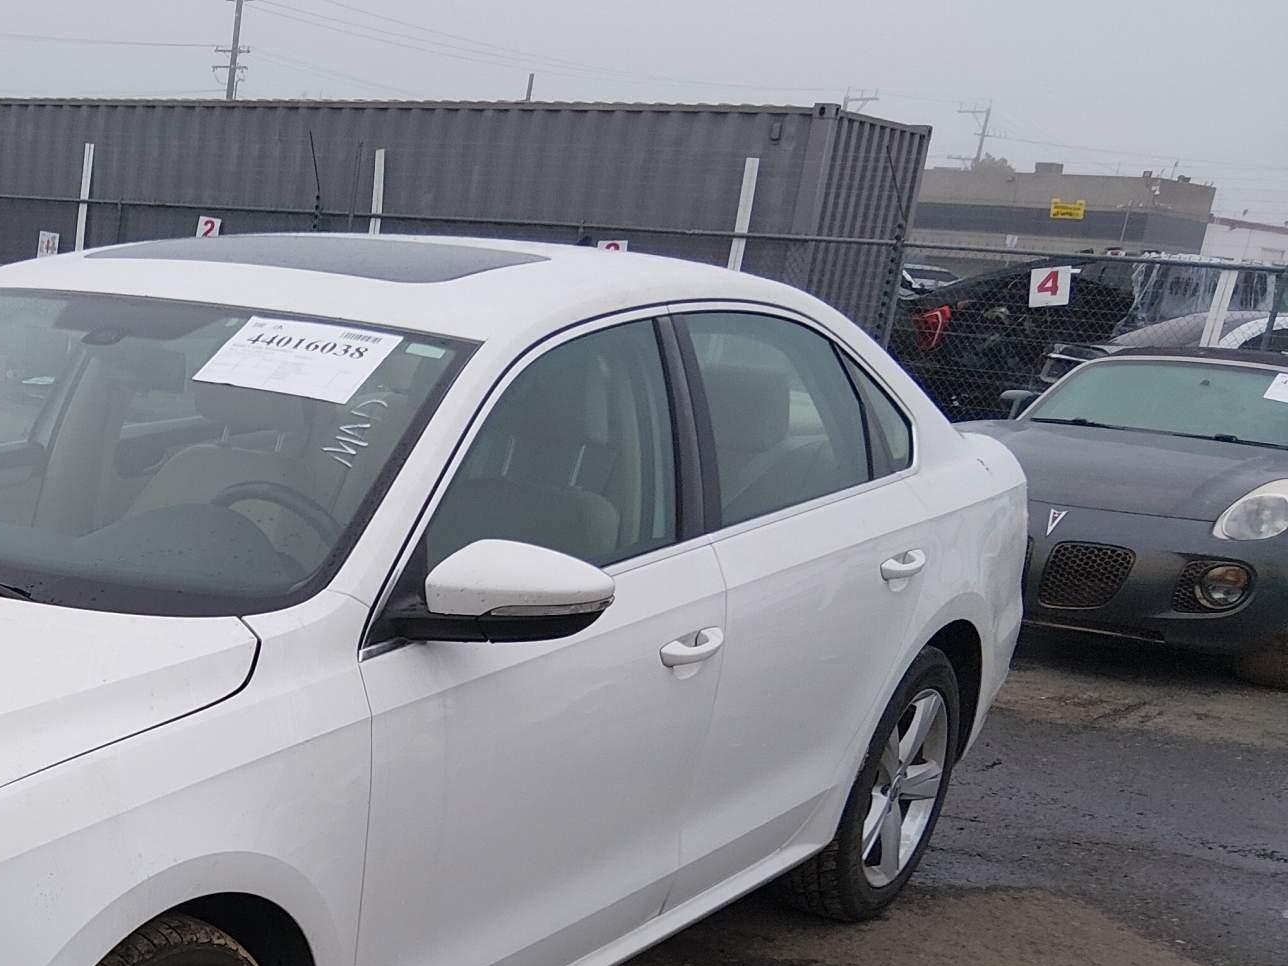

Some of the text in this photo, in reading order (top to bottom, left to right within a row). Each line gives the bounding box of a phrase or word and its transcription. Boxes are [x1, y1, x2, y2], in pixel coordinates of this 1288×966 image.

[202, 219, 215, 237] 2
[1036, 270, 1060, 297] 4
[247, 332, 369, 360] 44016038
